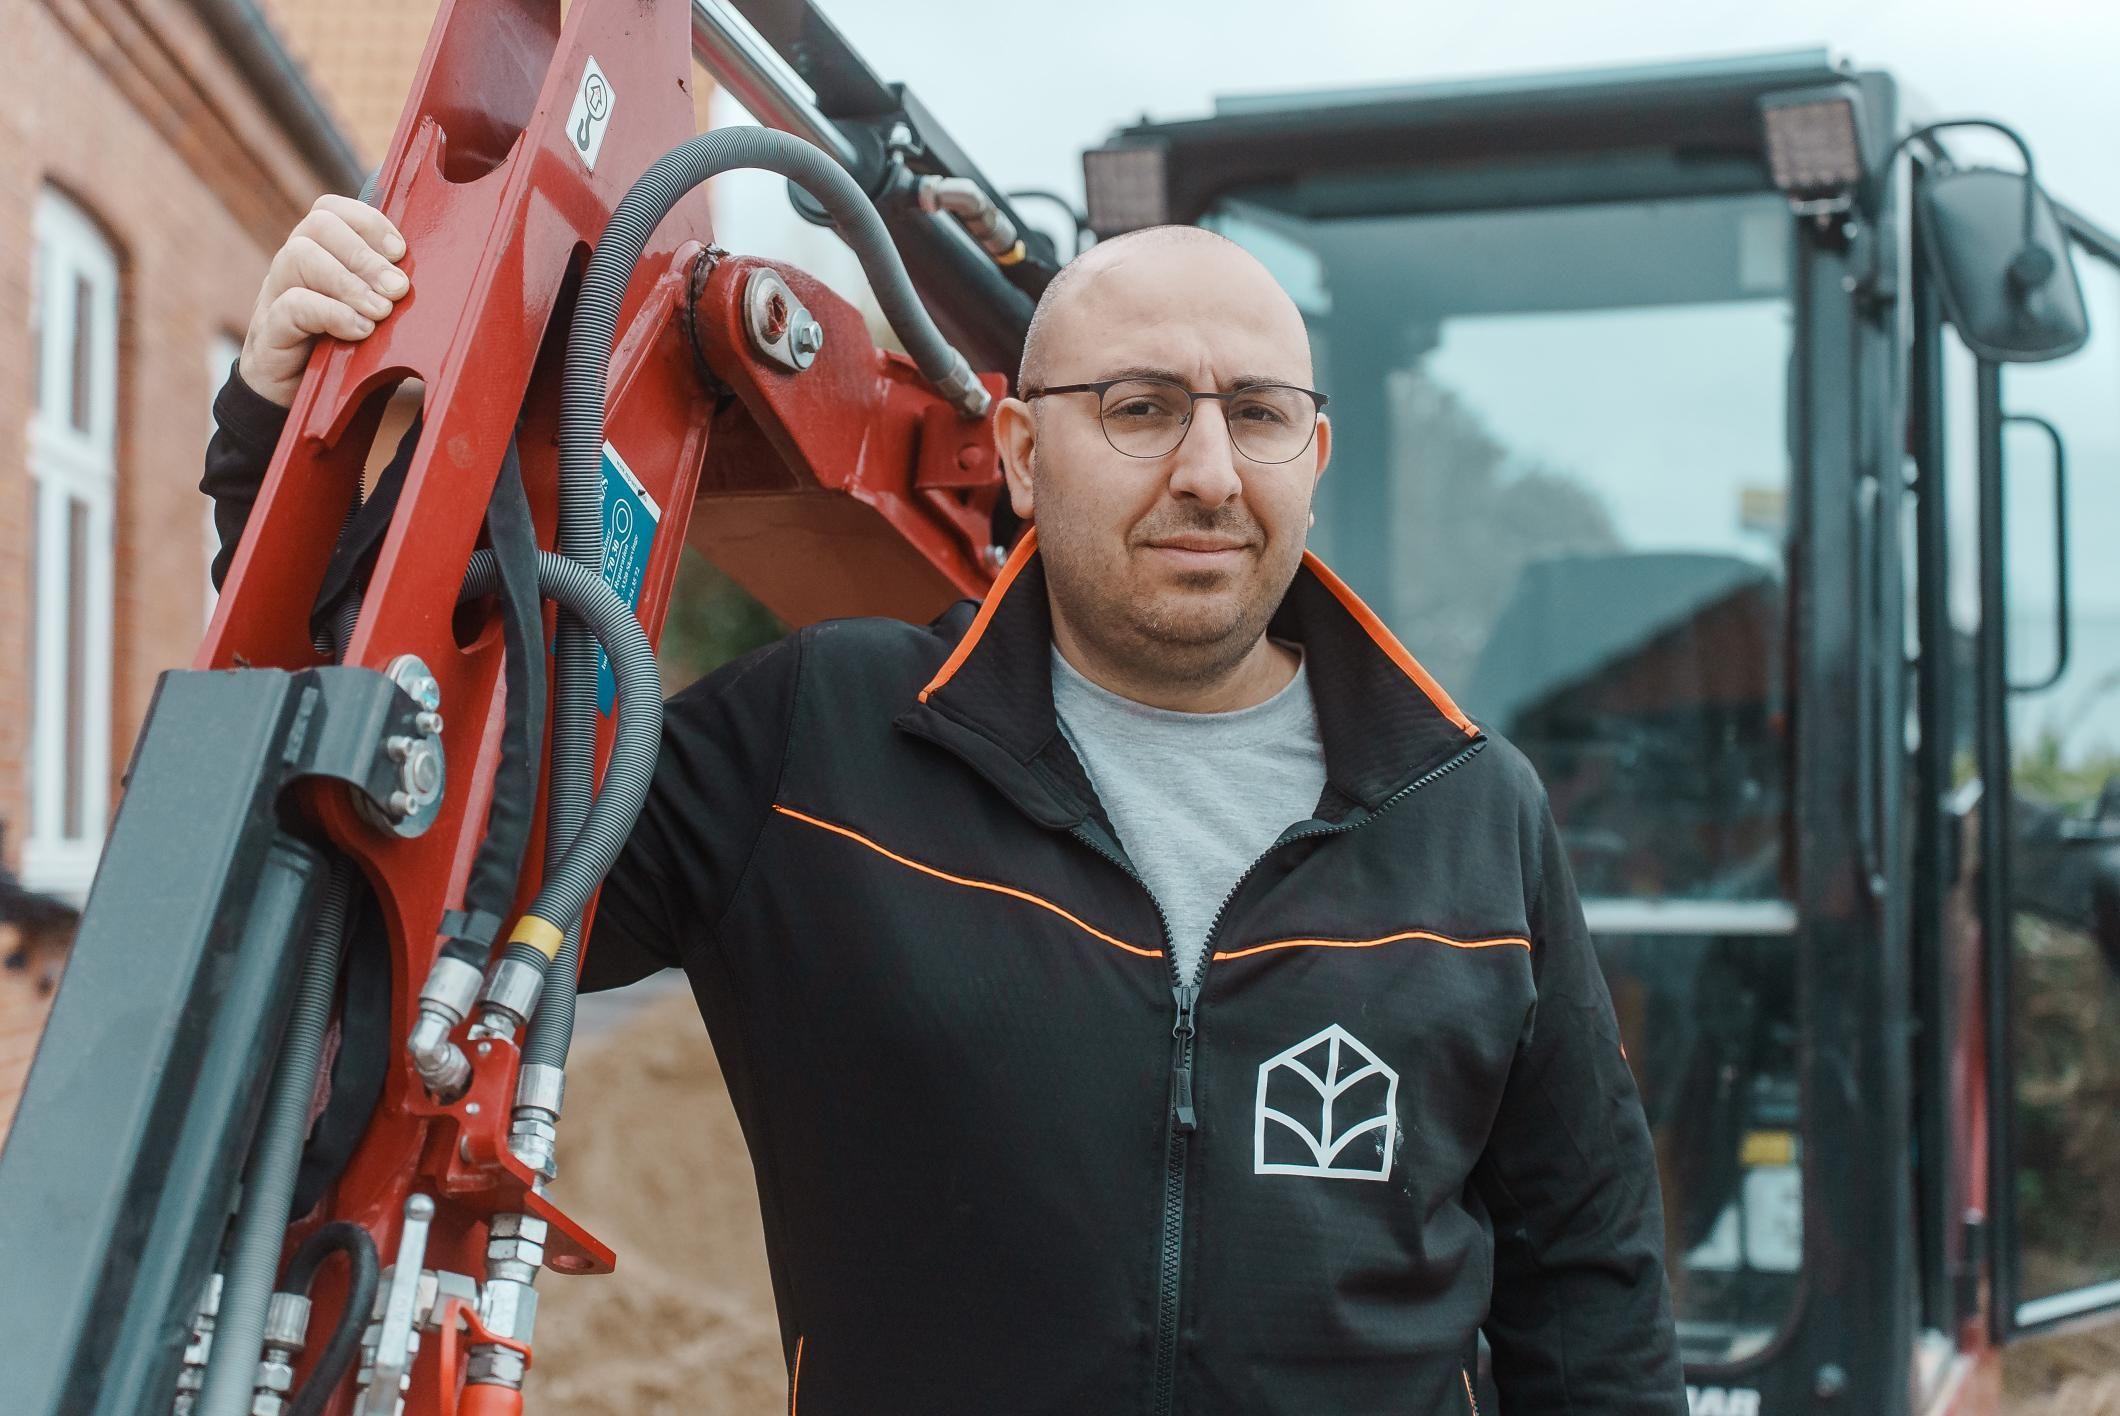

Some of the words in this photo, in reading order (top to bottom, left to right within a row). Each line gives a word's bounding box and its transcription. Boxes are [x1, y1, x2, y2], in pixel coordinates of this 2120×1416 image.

[611, 539, 620, 557] 30
[607, 556, 616, 573] 70
[614, 543, 629, 590] Reparation
